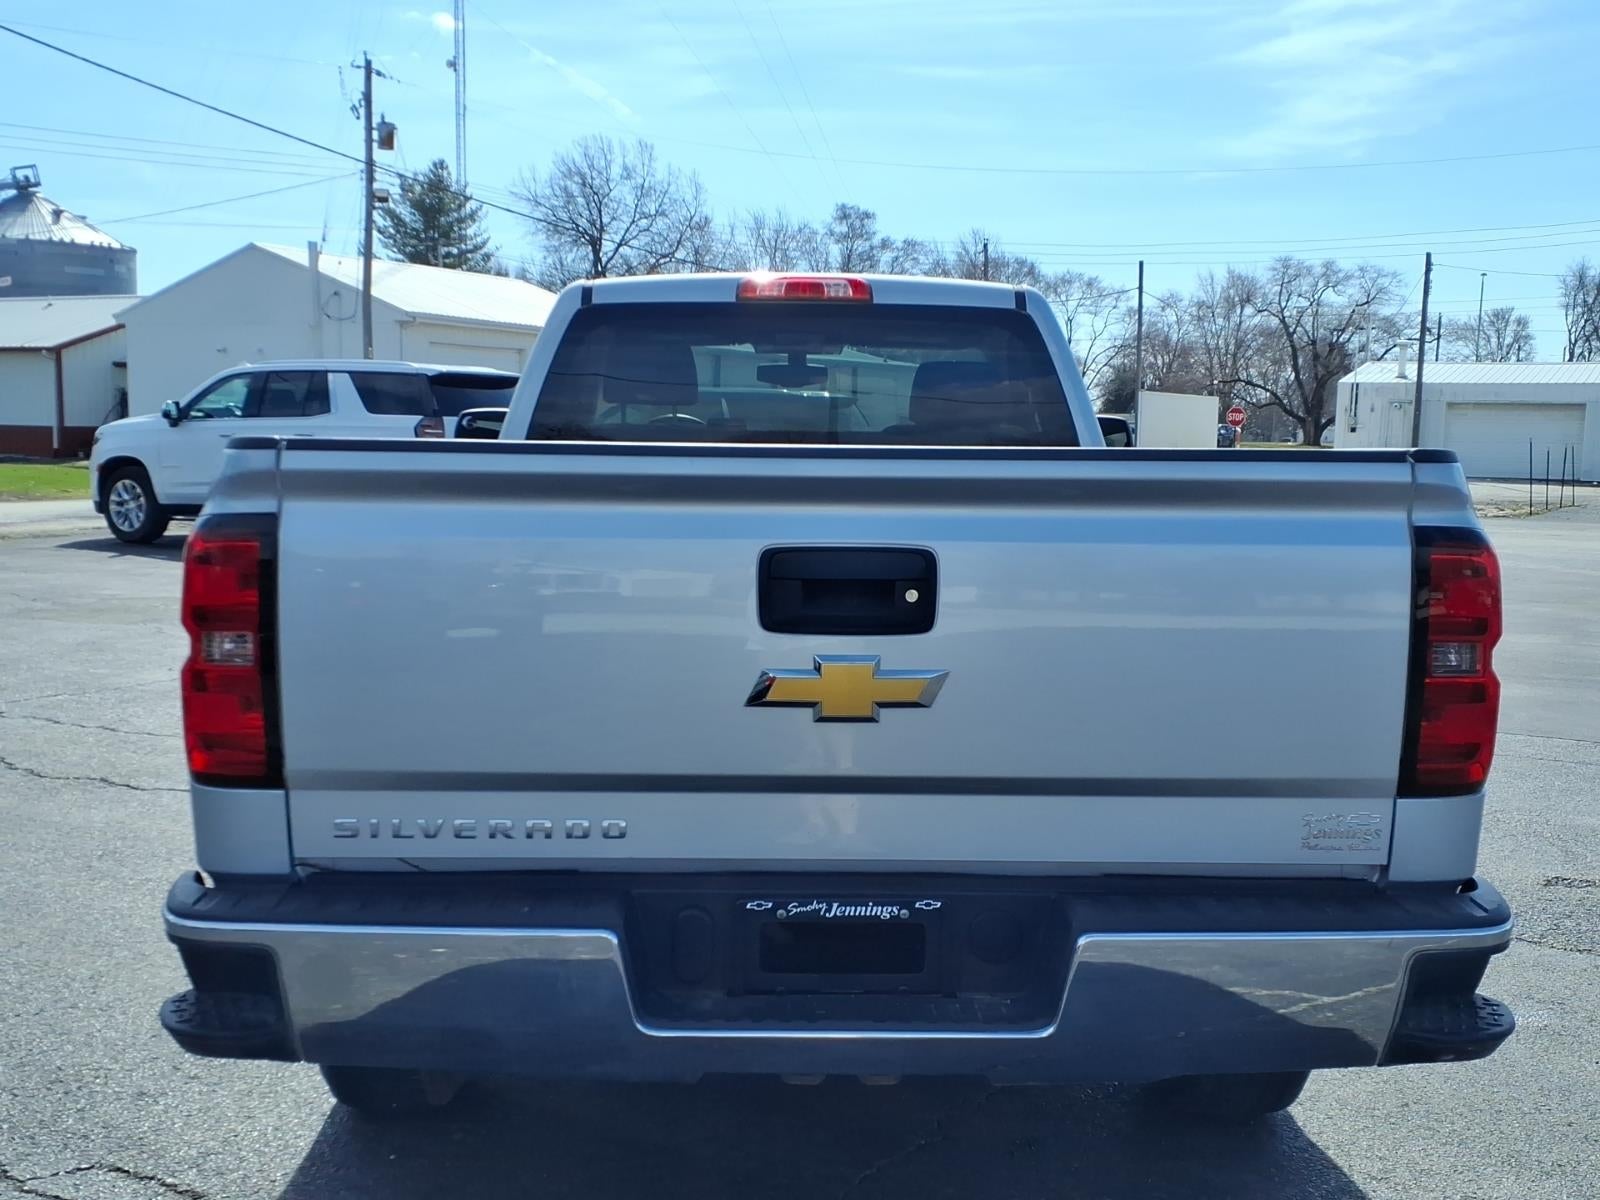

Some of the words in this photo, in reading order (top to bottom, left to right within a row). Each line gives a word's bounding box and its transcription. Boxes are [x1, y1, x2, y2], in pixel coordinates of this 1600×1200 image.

[1228, 412, 1244, 421] STOP
[333, 818, 628, 839] SILVERADO
[825, 901, 900, 920] Jennings
